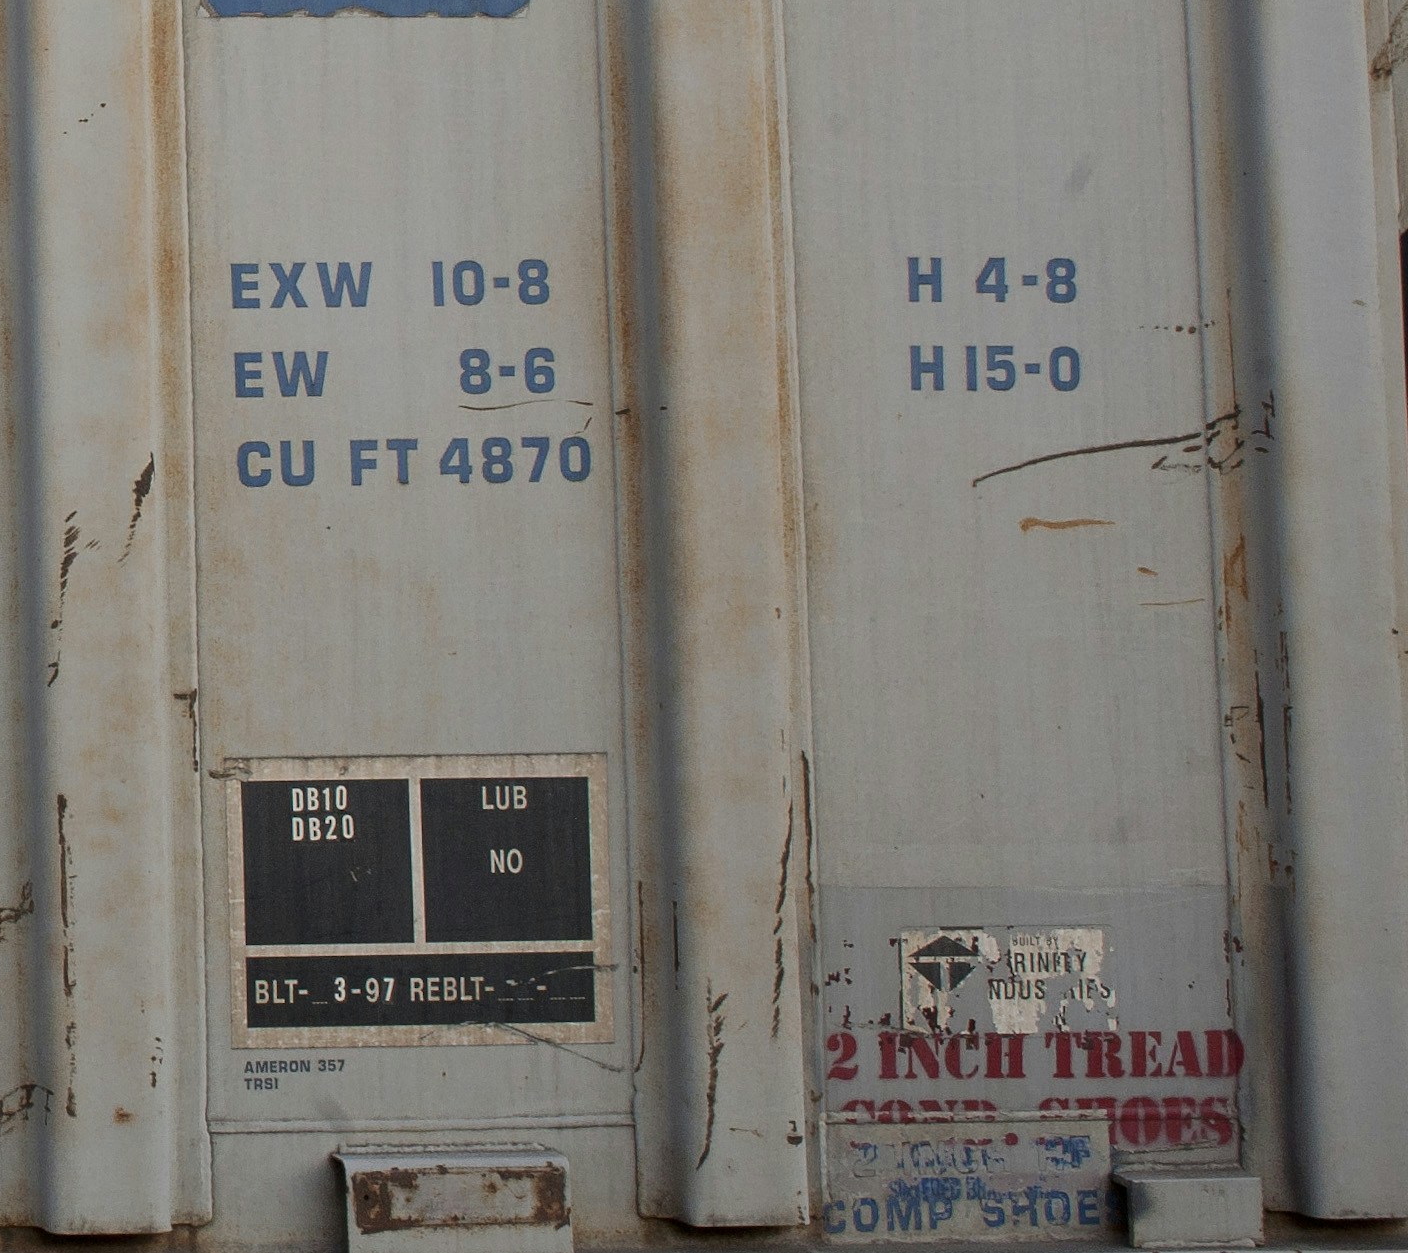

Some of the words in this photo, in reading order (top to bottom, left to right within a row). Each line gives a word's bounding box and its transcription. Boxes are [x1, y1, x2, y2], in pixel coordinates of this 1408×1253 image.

[230, 261, 373, 308] EXW
[432, 259, 550, 307] 10-8
[907, 257, 942, 303] H
[975, 257, 1077, 304] 4-8
[234, 351, 329, 398] EW
[459, 347, 556, 394] 8-6
[909, 345, 945, 391] H
[965, 345, 1080, 392] 15-0
[237, 440, 315, 488] CU
[350, 438, 418, 486] FT
[439, 436, 592, 484] 4870
[291, 785, 348, 813] DB10
[481, 785, 528, 811] LUB
[291, 814, 356, 841] DB20
[490, 849, 523, 874] NO
[1012, 935, 1040, 947] BUILT
[1046, 935, 1059, 947] BY
[244, 1060, 311, 1074] AMERON
[318, 1059, 345, 1072] 357
[827, 1032, 859, 1081] 2
[878, 1032, 1027, 1081] INCH
[1044, 1029, 1245, 1080] TREAD
[823, 1197, 954, 1235] COMP
